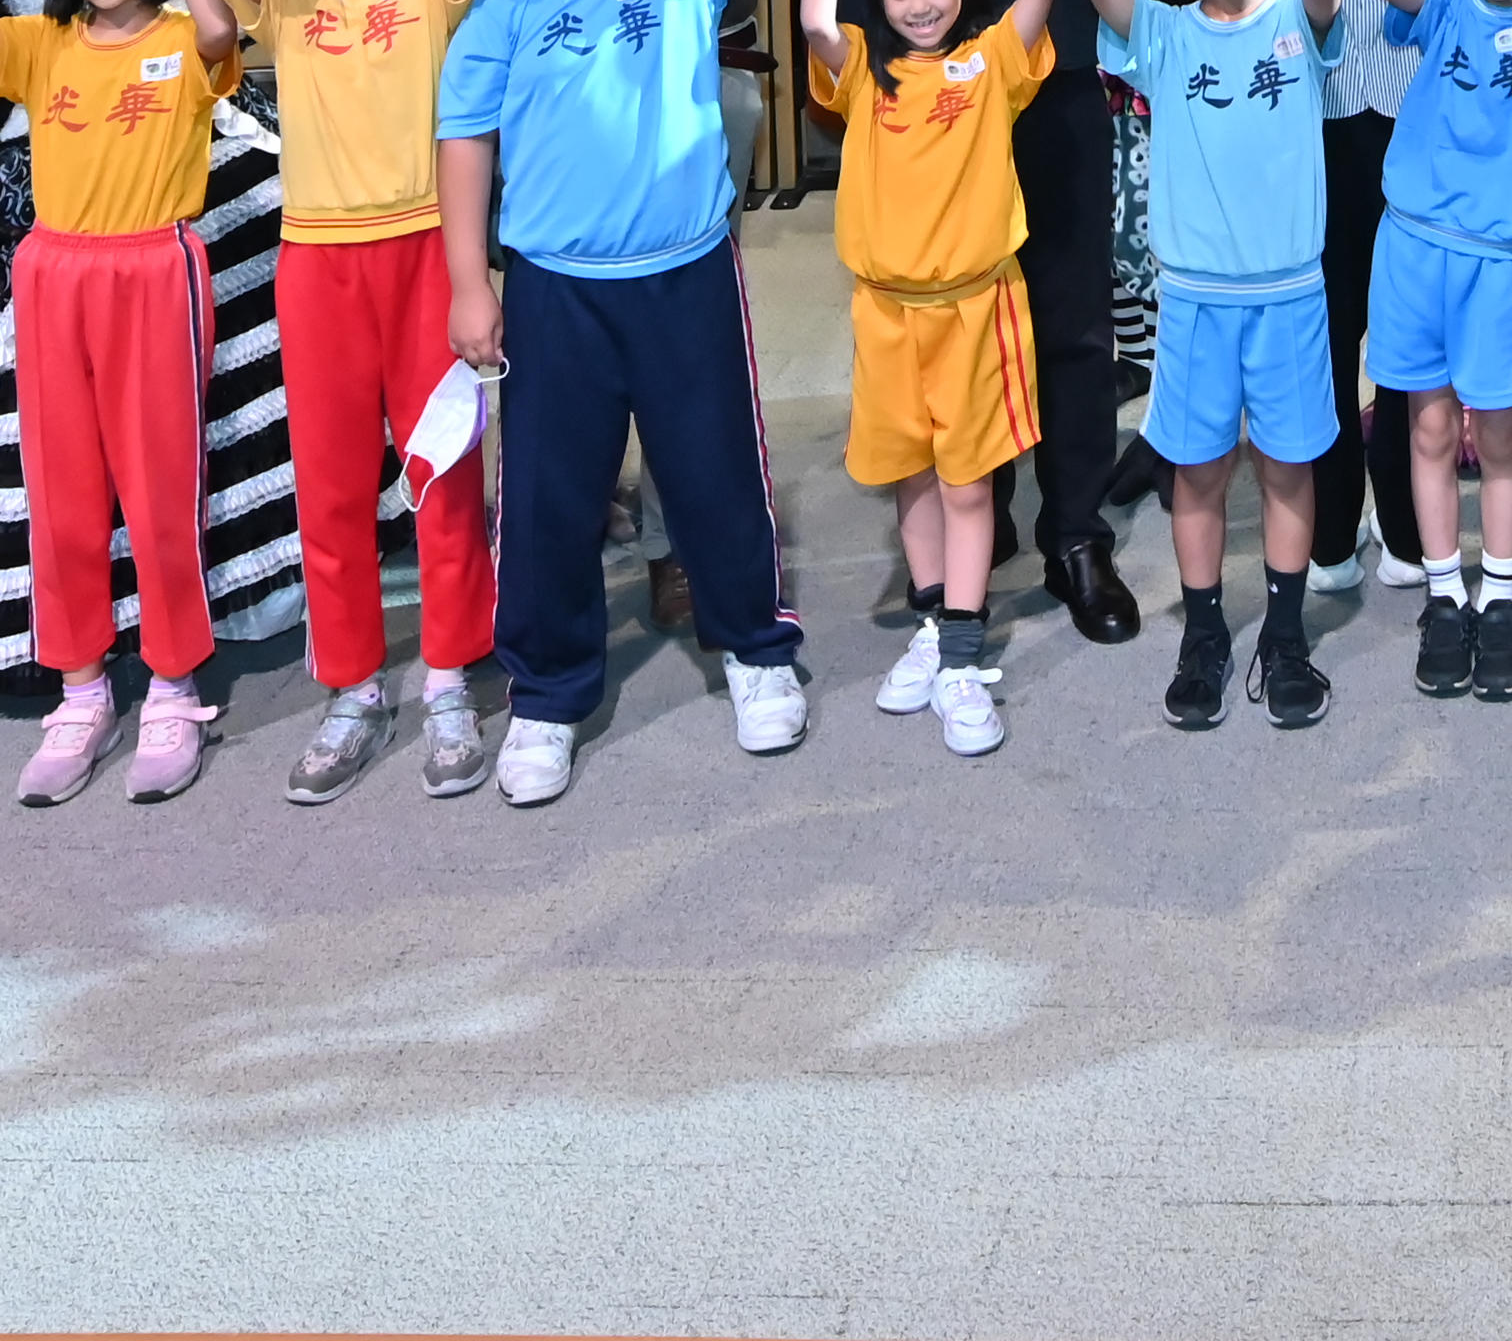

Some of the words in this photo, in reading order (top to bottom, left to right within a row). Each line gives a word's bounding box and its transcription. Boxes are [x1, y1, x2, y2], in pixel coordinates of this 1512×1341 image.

[303, 0, 420, 55] 光華
[41, 81, 172, 136] 光華
[873, 84, 976, 133] 光華
[1186, 54, 1301, 110] 光華
